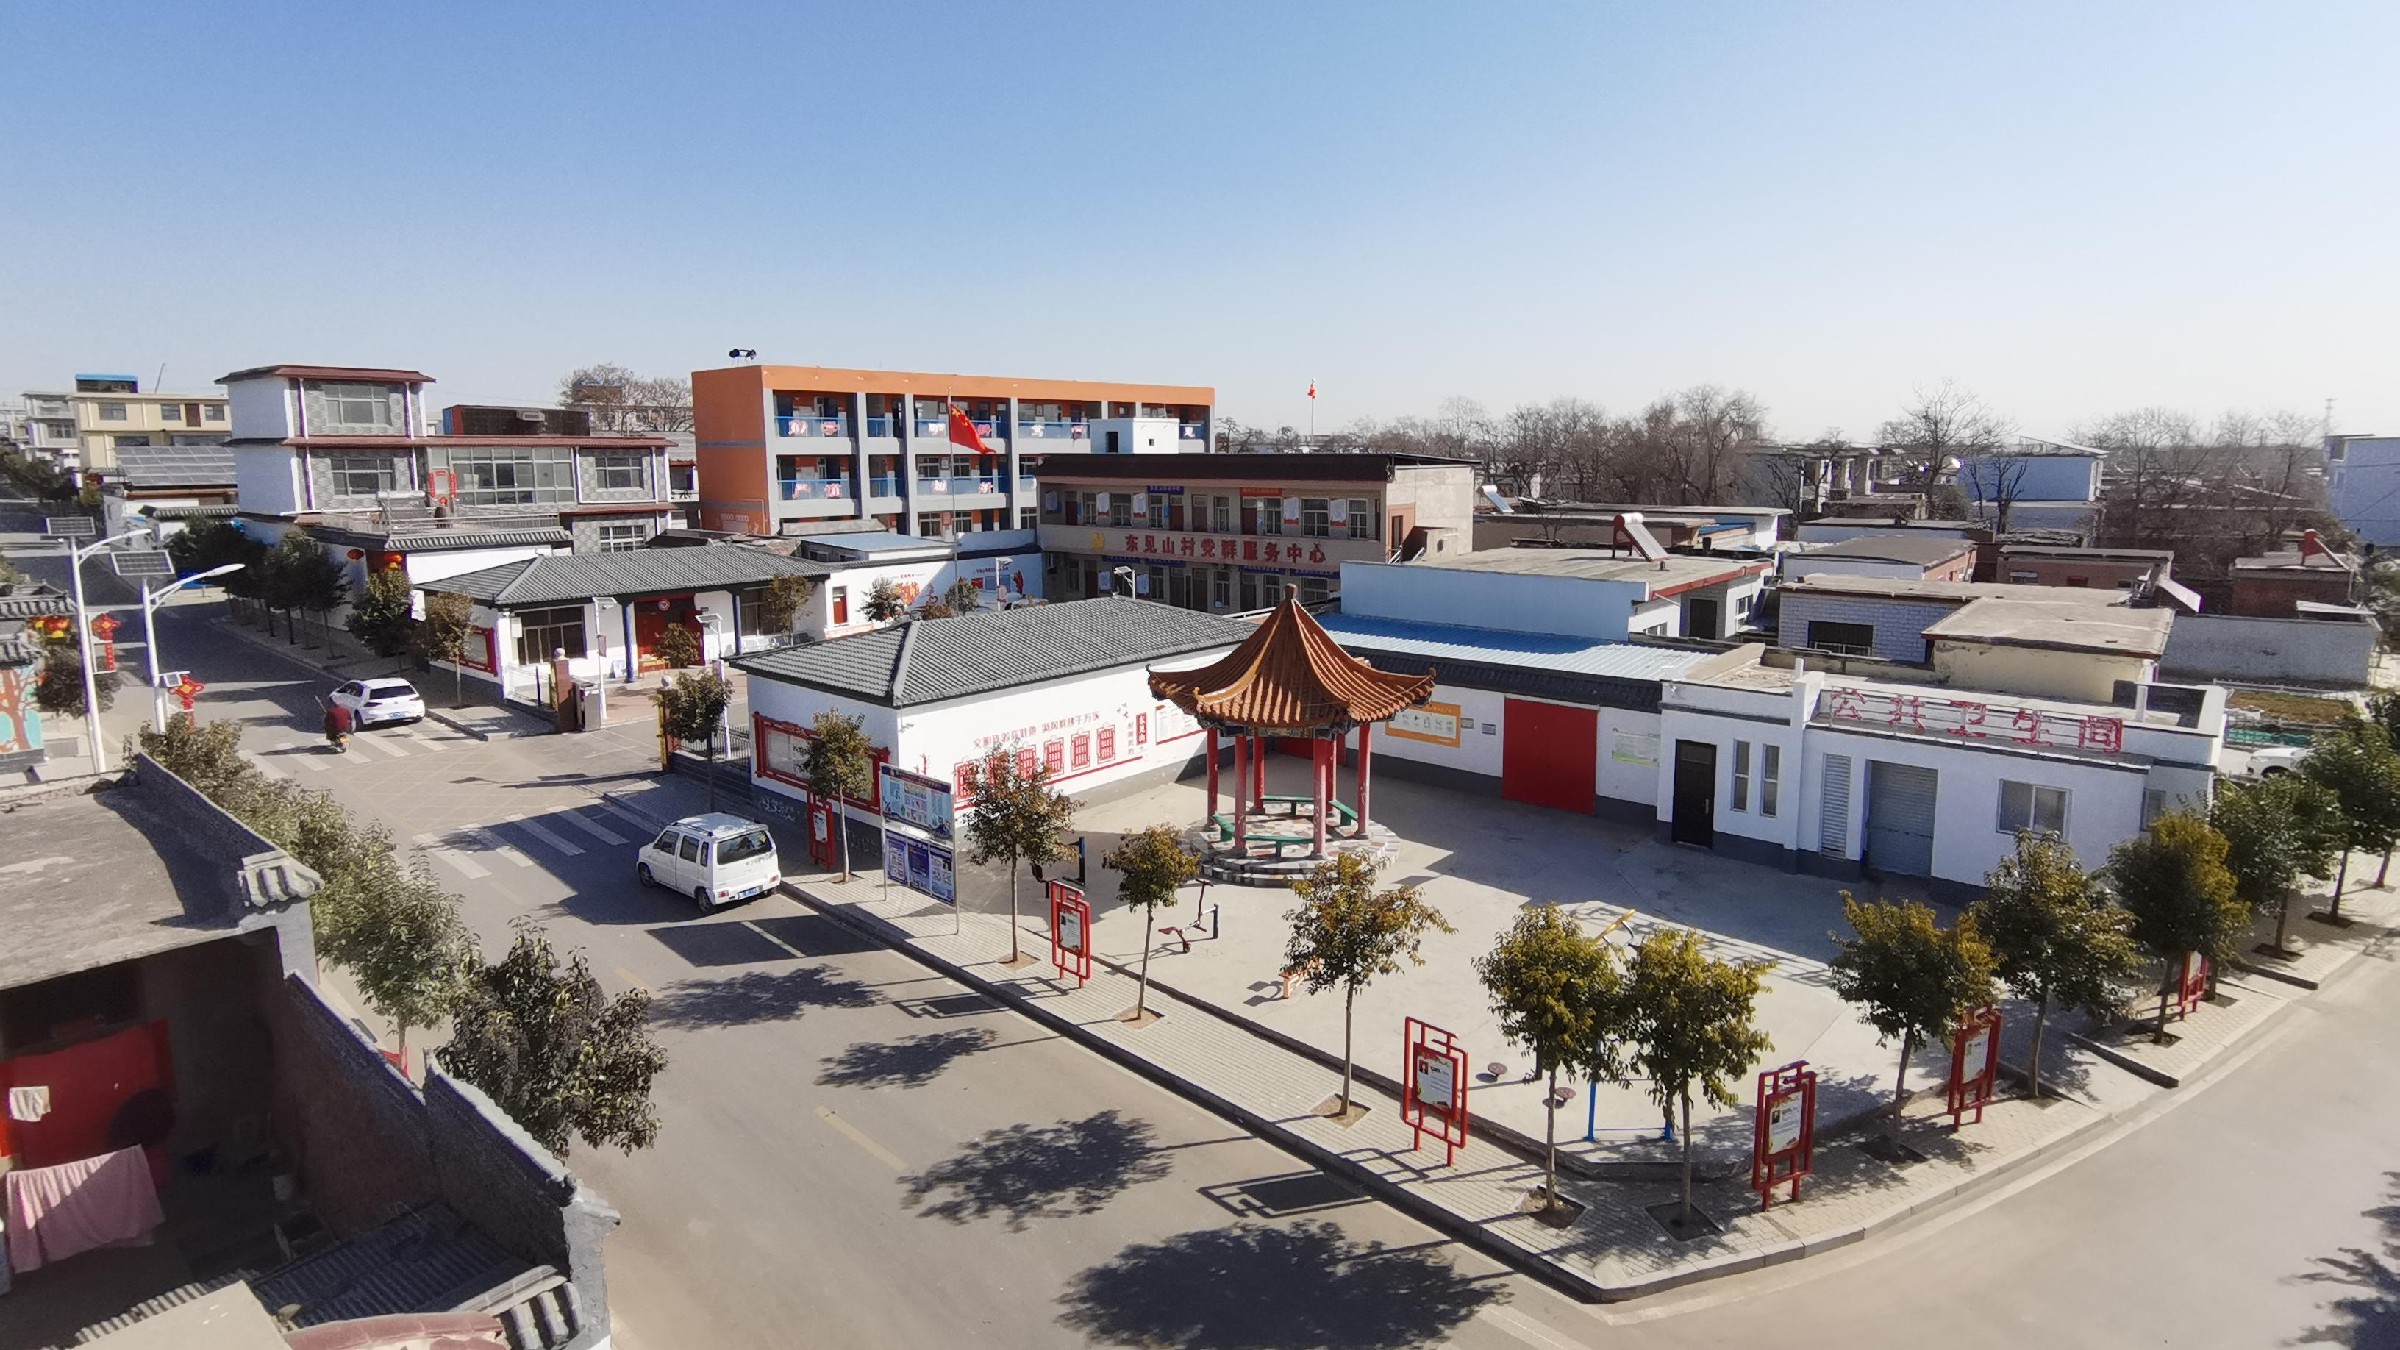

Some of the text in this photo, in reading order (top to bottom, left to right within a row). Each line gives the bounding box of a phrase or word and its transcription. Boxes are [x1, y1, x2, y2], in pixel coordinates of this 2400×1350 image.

[1125, 534, 1326, 564] 东见山村党群服务中心
[1830, 687, 2122, 753] 公共卫生间
